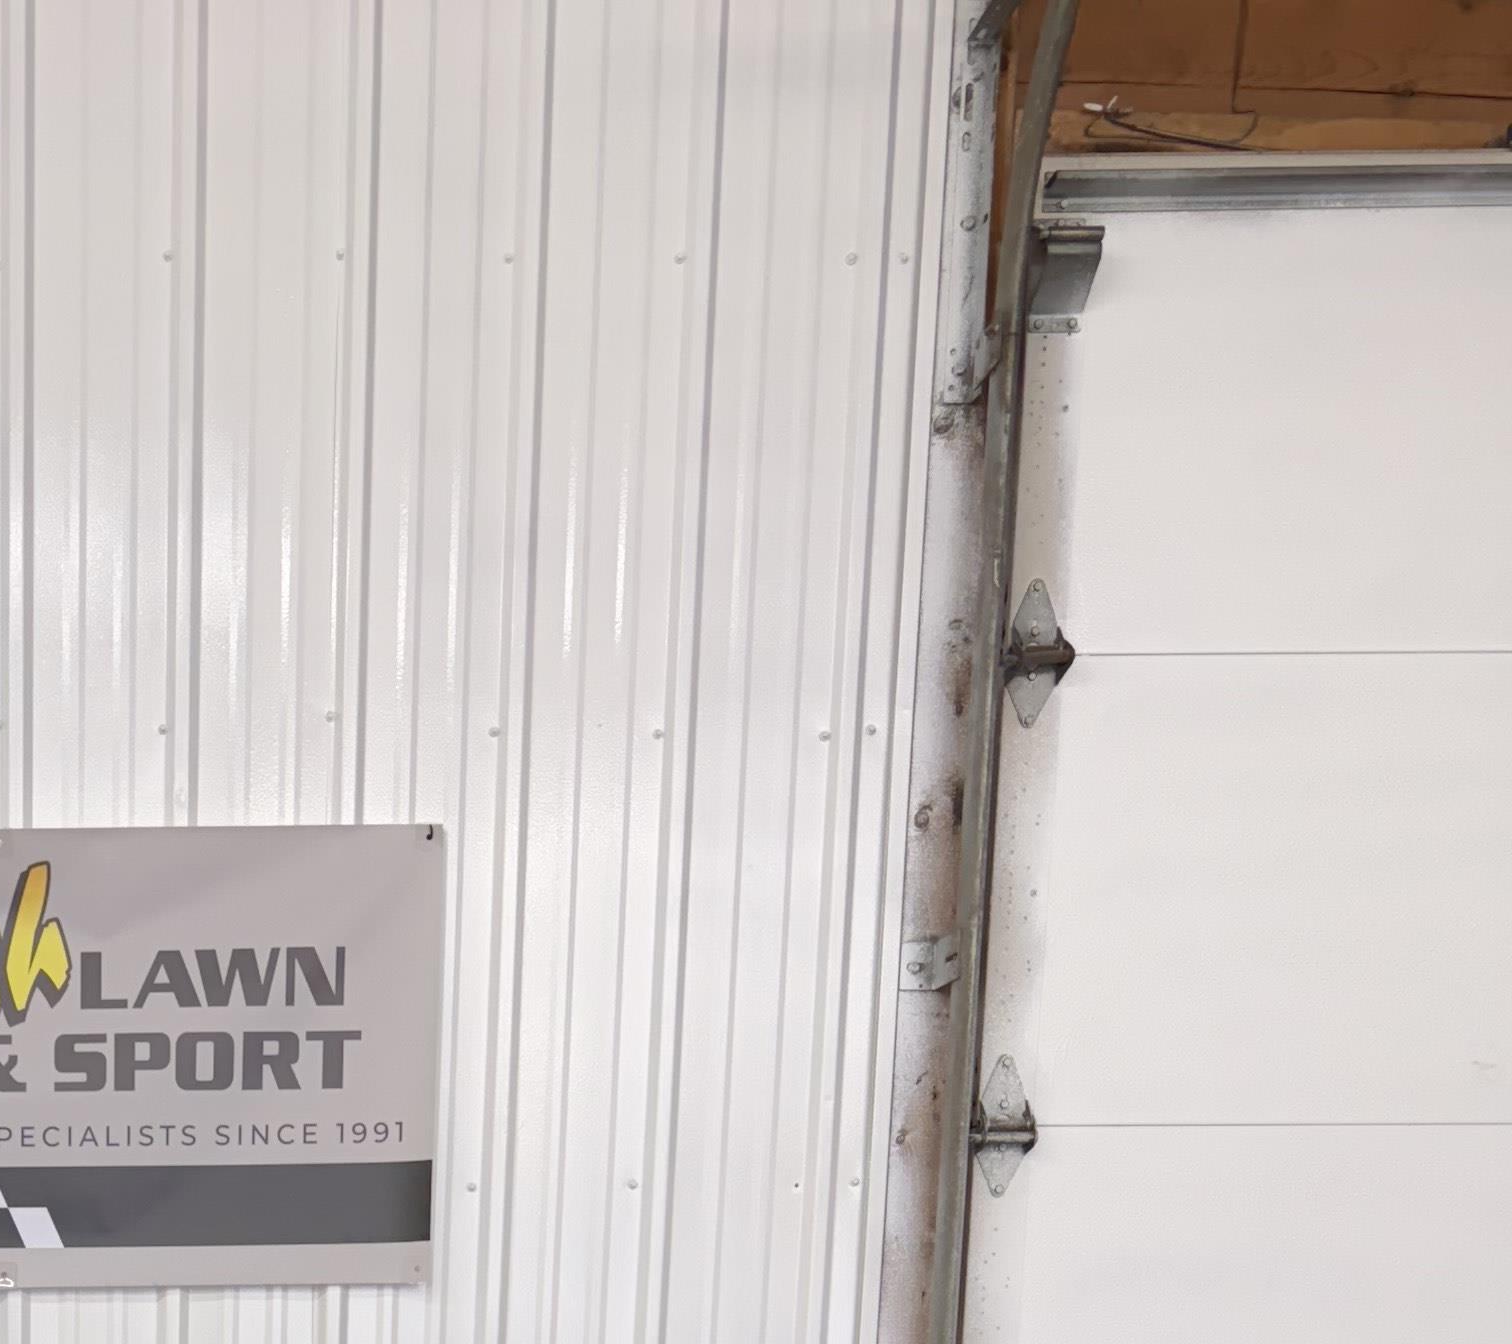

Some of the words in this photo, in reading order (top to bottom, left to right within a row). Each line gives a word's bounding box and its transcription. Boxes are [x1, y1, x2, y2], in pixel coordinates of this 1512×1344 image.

[80, 946, 346, 1010] LAWN
[54, 1030, 362, 1092] SPORT
[215, 1123, 319, 1147] SINCE
[336, 1121, 405, 1145] 1991
